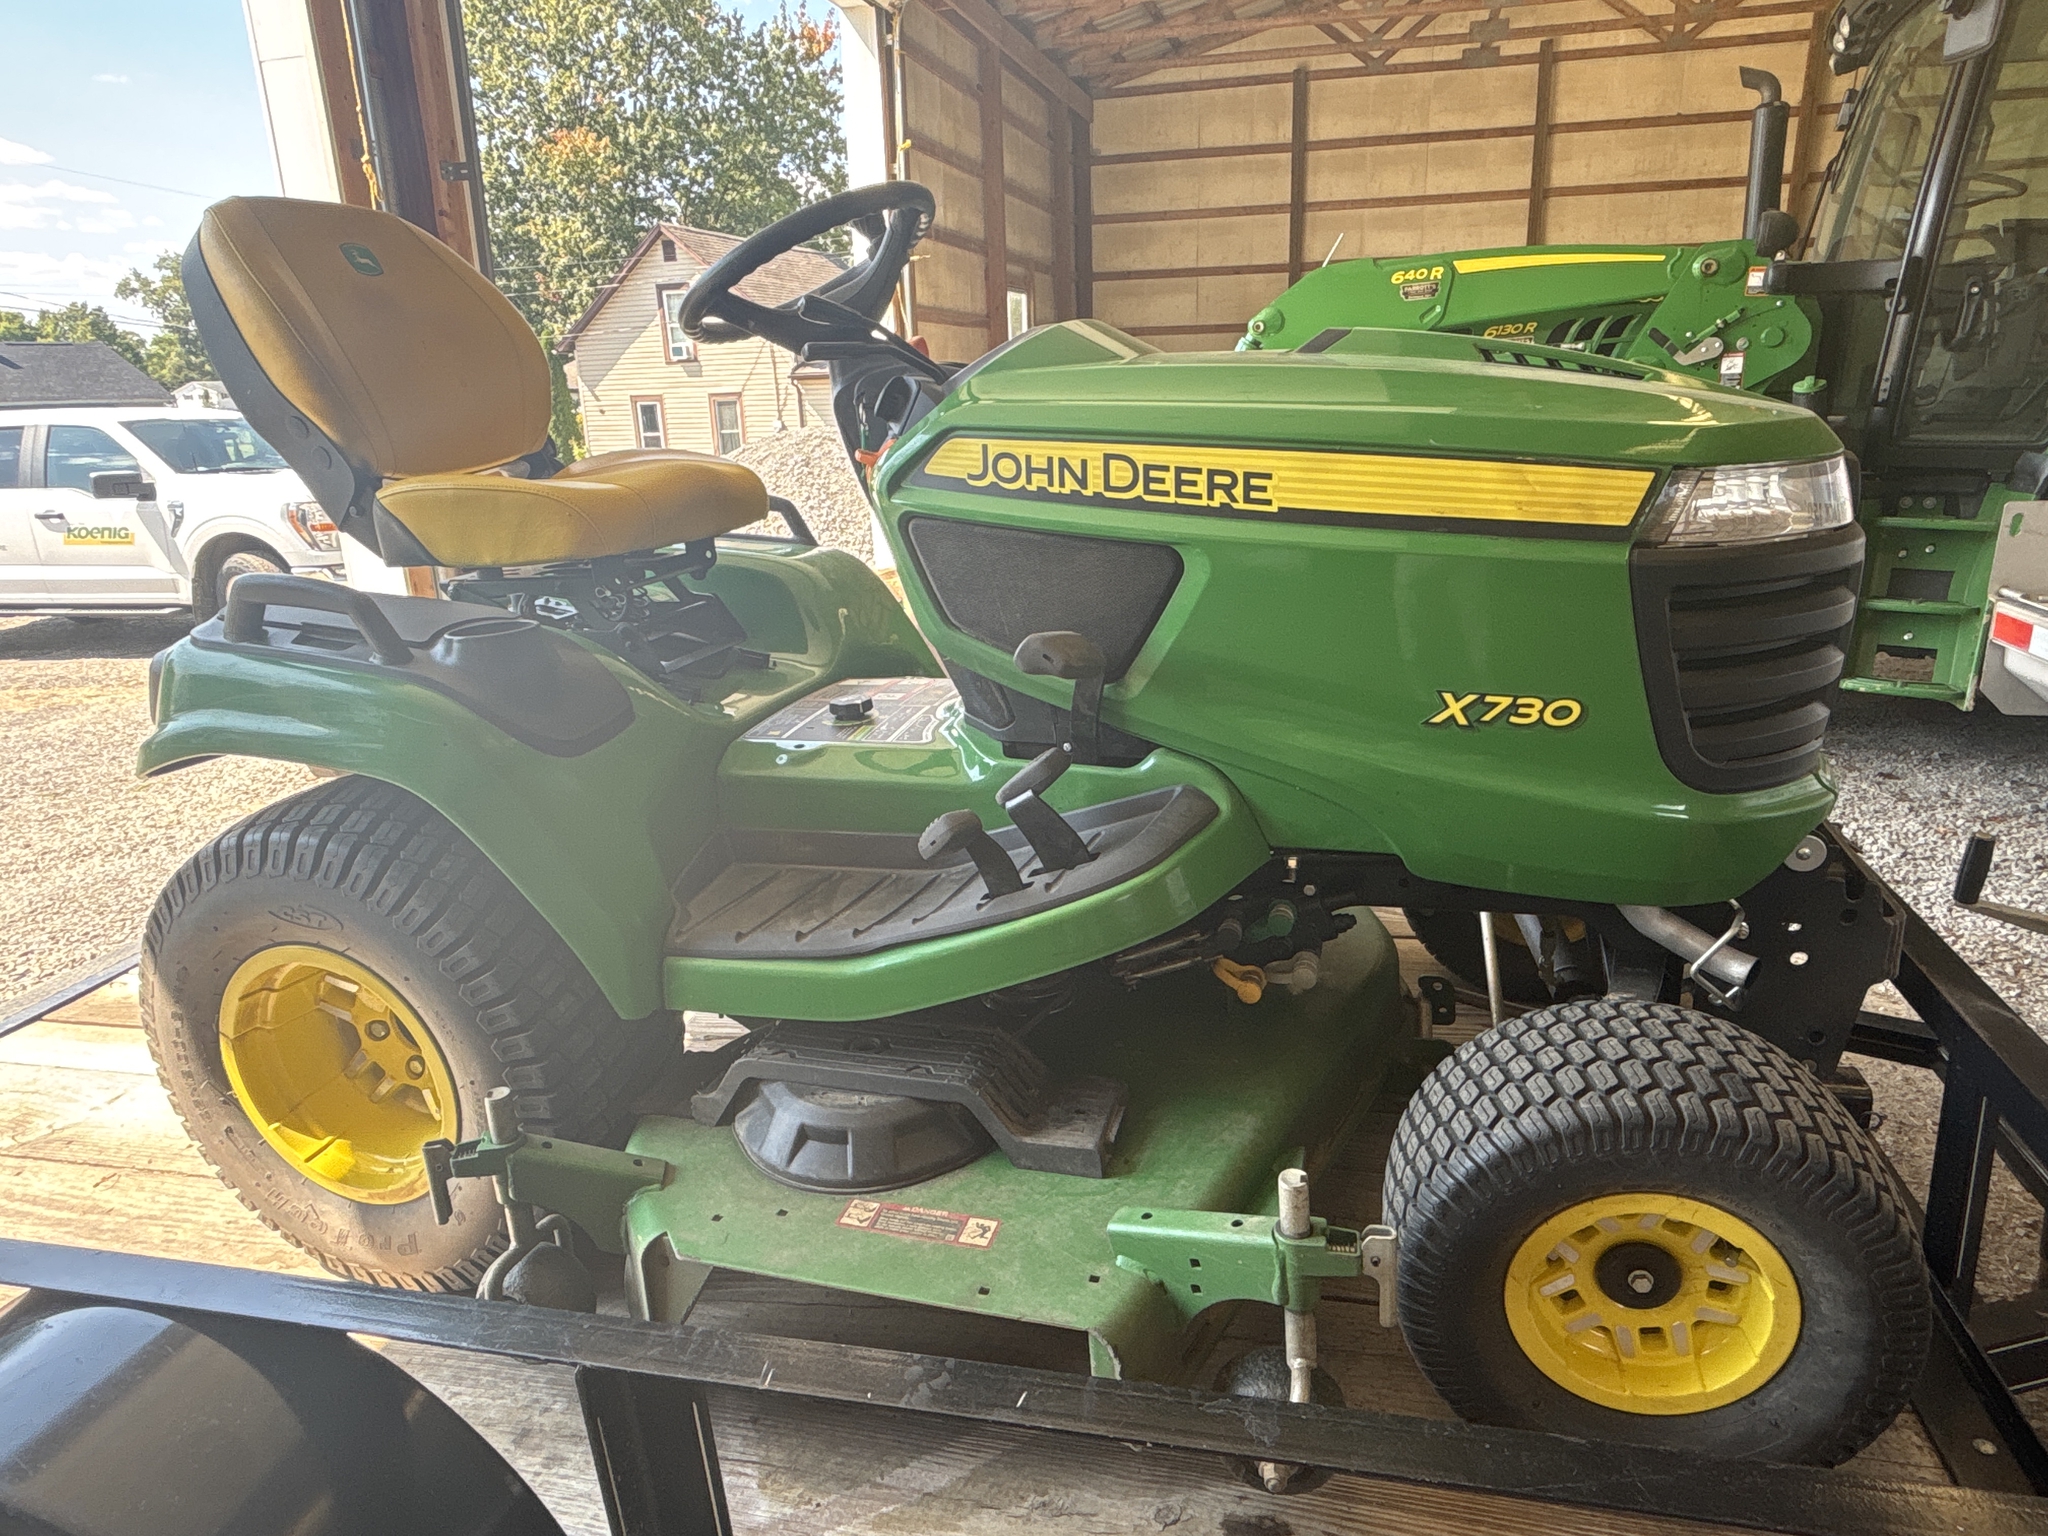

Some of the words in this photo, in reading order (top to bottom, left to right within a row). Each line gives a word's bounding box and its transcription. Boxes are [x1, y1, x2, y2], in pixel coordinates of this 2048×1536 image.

[1391, 268, 1428, 284] 640
[1484, 323, 1523, 339] 6130
[966, 443, 1089, 492] JOHN
[1102, 451, 1275, 508] DEERE
[1425, 691, 1584, 728] X730
